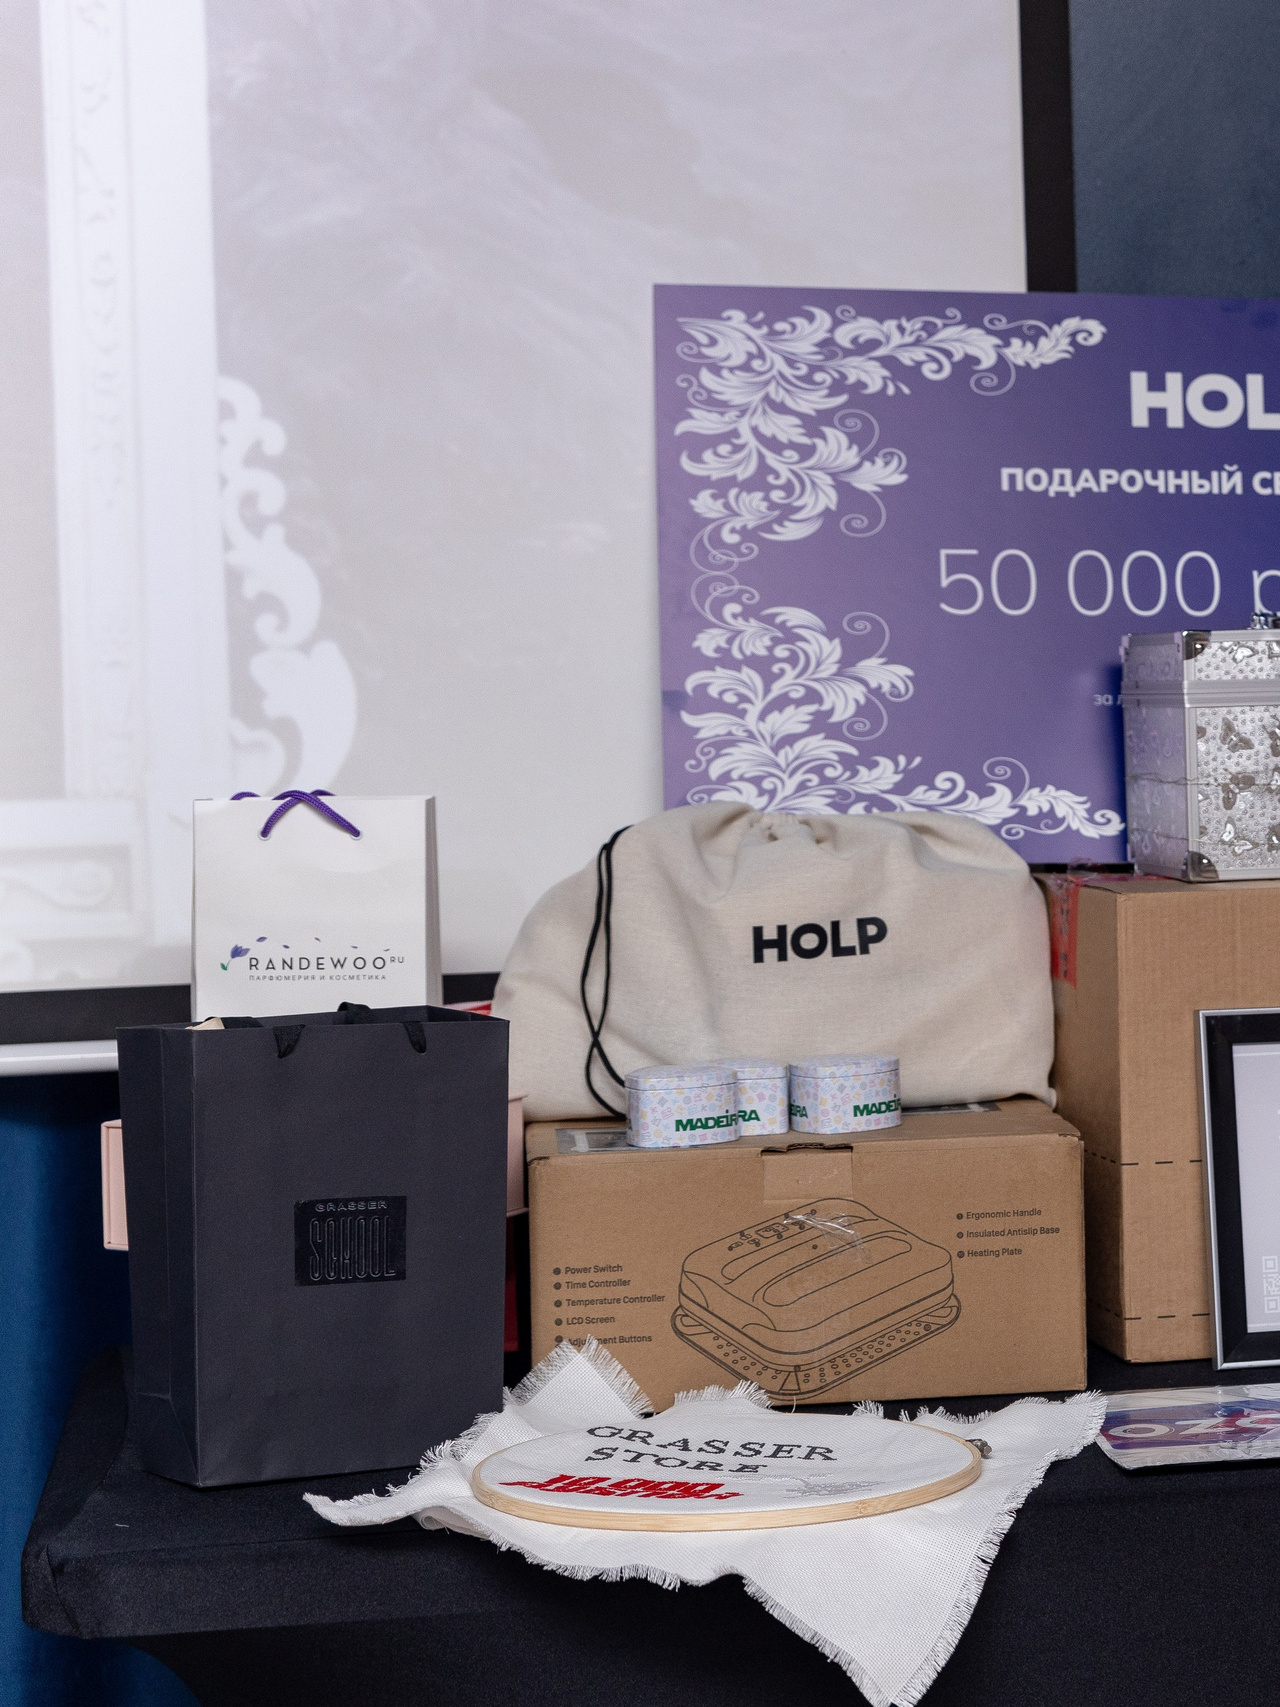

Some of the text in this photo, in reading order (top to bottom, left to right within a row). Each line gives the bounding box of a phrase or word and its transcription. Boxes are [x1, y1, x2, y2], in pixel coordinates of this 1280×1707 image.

[1000, 464, 1243, 498] ПОДАРОЧНЫЙ
[938, 548, 1038, 616] 50
[1067, 549, 1221, 617] 000
[752, 916, 888, 963] HOLP
[249, 956, 387, 971] RANDEWOO
[315, 1200, 388, 1212] GRASSER
[966, 1208, 1042, 1220] Ergonomic Handle
[966, 1226, 1060, 1238] Insulated Antislip Base
[309, 1215, 396, 1281] SCHOOL
[967, 1247, 1022, 1258] Heating Plate
[565, 1264, 623, 1275] Power Switch
[565, 1279, 631, 1290] Time Controller
[566, 1294, 665, 1308] Temperature Controller
[566, 1315, 616, 1325] LCD Screen
[619, 1335, 652, 1344] Buttons
[586, 1425, 838, 1461] GRASSER
[584, 1446, 768, 1473] STORE
